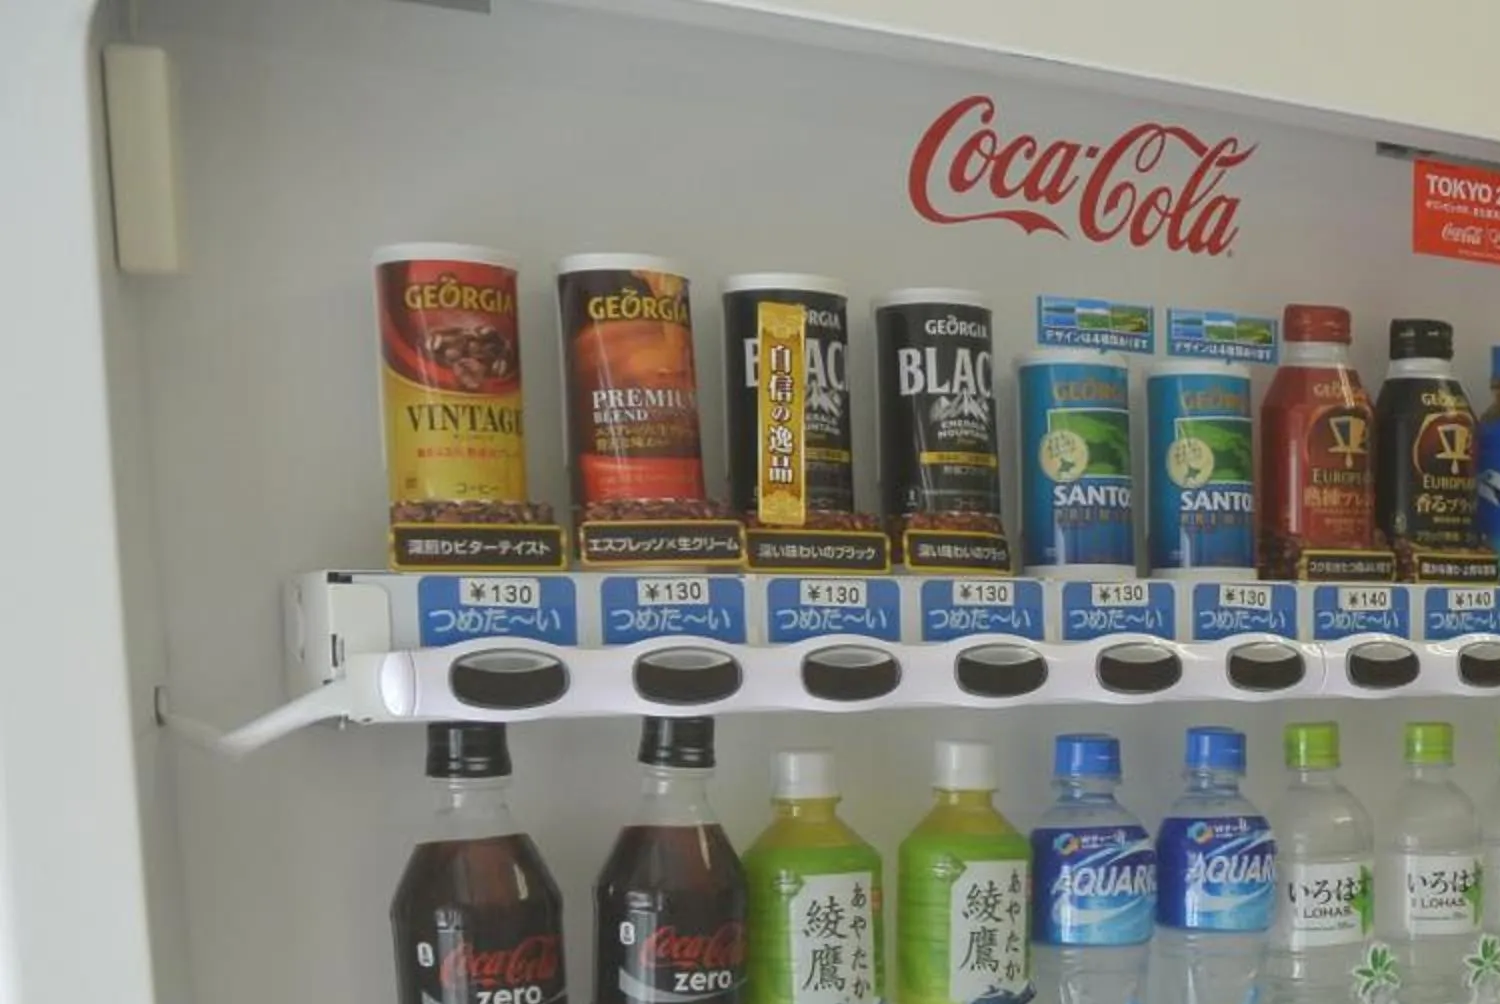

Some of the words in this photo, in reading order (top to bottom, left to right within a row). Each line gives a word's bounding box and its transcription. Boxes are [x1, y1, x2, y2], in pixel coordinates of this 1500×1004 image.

[908, 95, 1260, 256] Coca-Cola
[1425, 174, 1492, 204] TOKYO
[404, 276, 512, 313] GEORGIA
[768, 345, 794, 484] 自信の逸品
[407, 539, 551, 556] 深煎りビターテイスト
[758, 543, 876, 560] 深い味わいのブラック
[469, 582, 532, 604] ¥130
[645, 581, 702, 602] ¥130
[808, 584, 860, 604] ¥130
[960, 583, 1008, 603] ¥130
[1098, 585, 1143, 603] ¥130
[1225, 588, 1266, 607] ¥130
[1349, 592, 1388, 608] ¥140
[1455, 591, 1491, 607] ¥140
[429, 608, 561, 633] つめた～い
[611, 608, 732, 632] つめた～い
[776, 608, 888, 630] つめた～い
[928, 608, 1032, 630] つめた～い
[960, 880, 1004, 973] 綾鷹
[1005, 868, 1022, 978] あやたか
[803, 895, 847, 993] 綾鷹
[848, 881, 871, 1000] あやたか
[674, 969, 732, 992] zero
